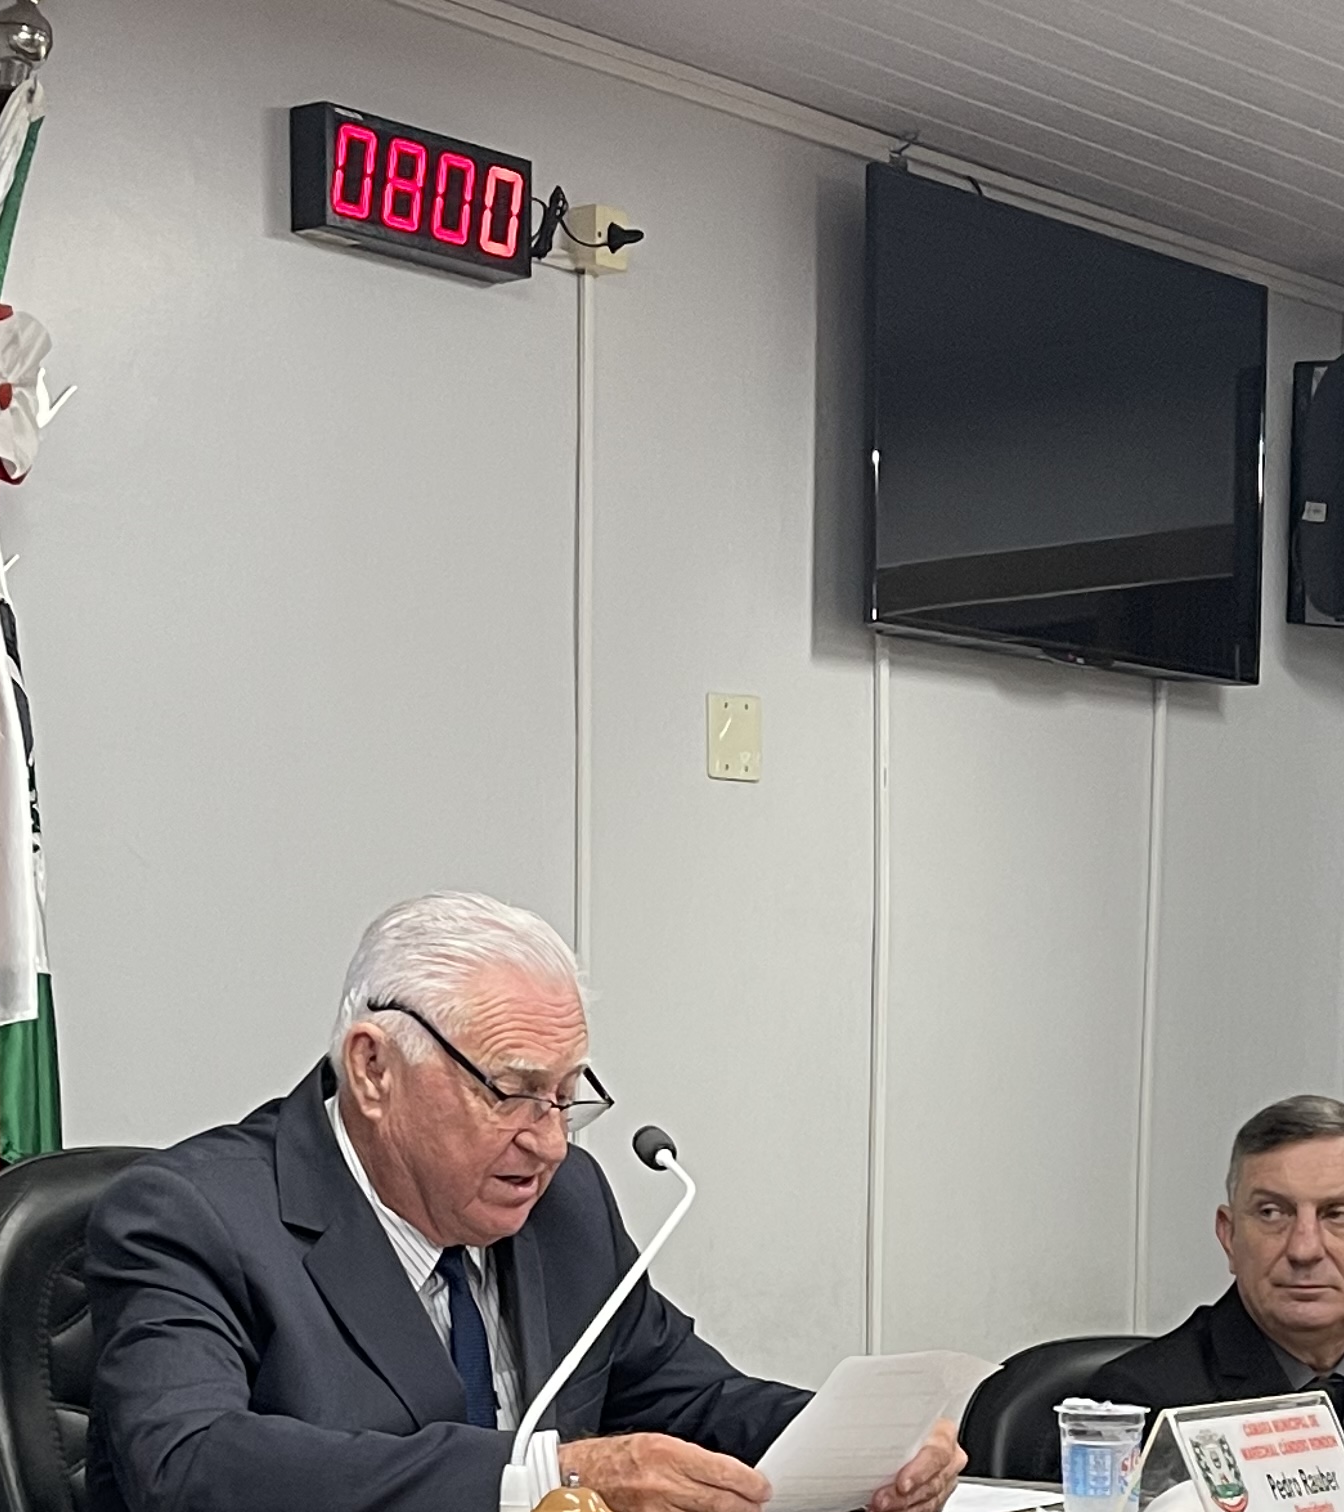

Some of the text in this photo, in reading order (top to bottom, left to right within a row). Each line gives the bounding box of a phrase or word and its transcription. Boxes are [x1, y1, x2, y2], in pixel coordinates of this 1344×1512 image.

[331, 121, 524, 258] 0800
[1265, 1465, 1340, 1501] Pedro Rauber
